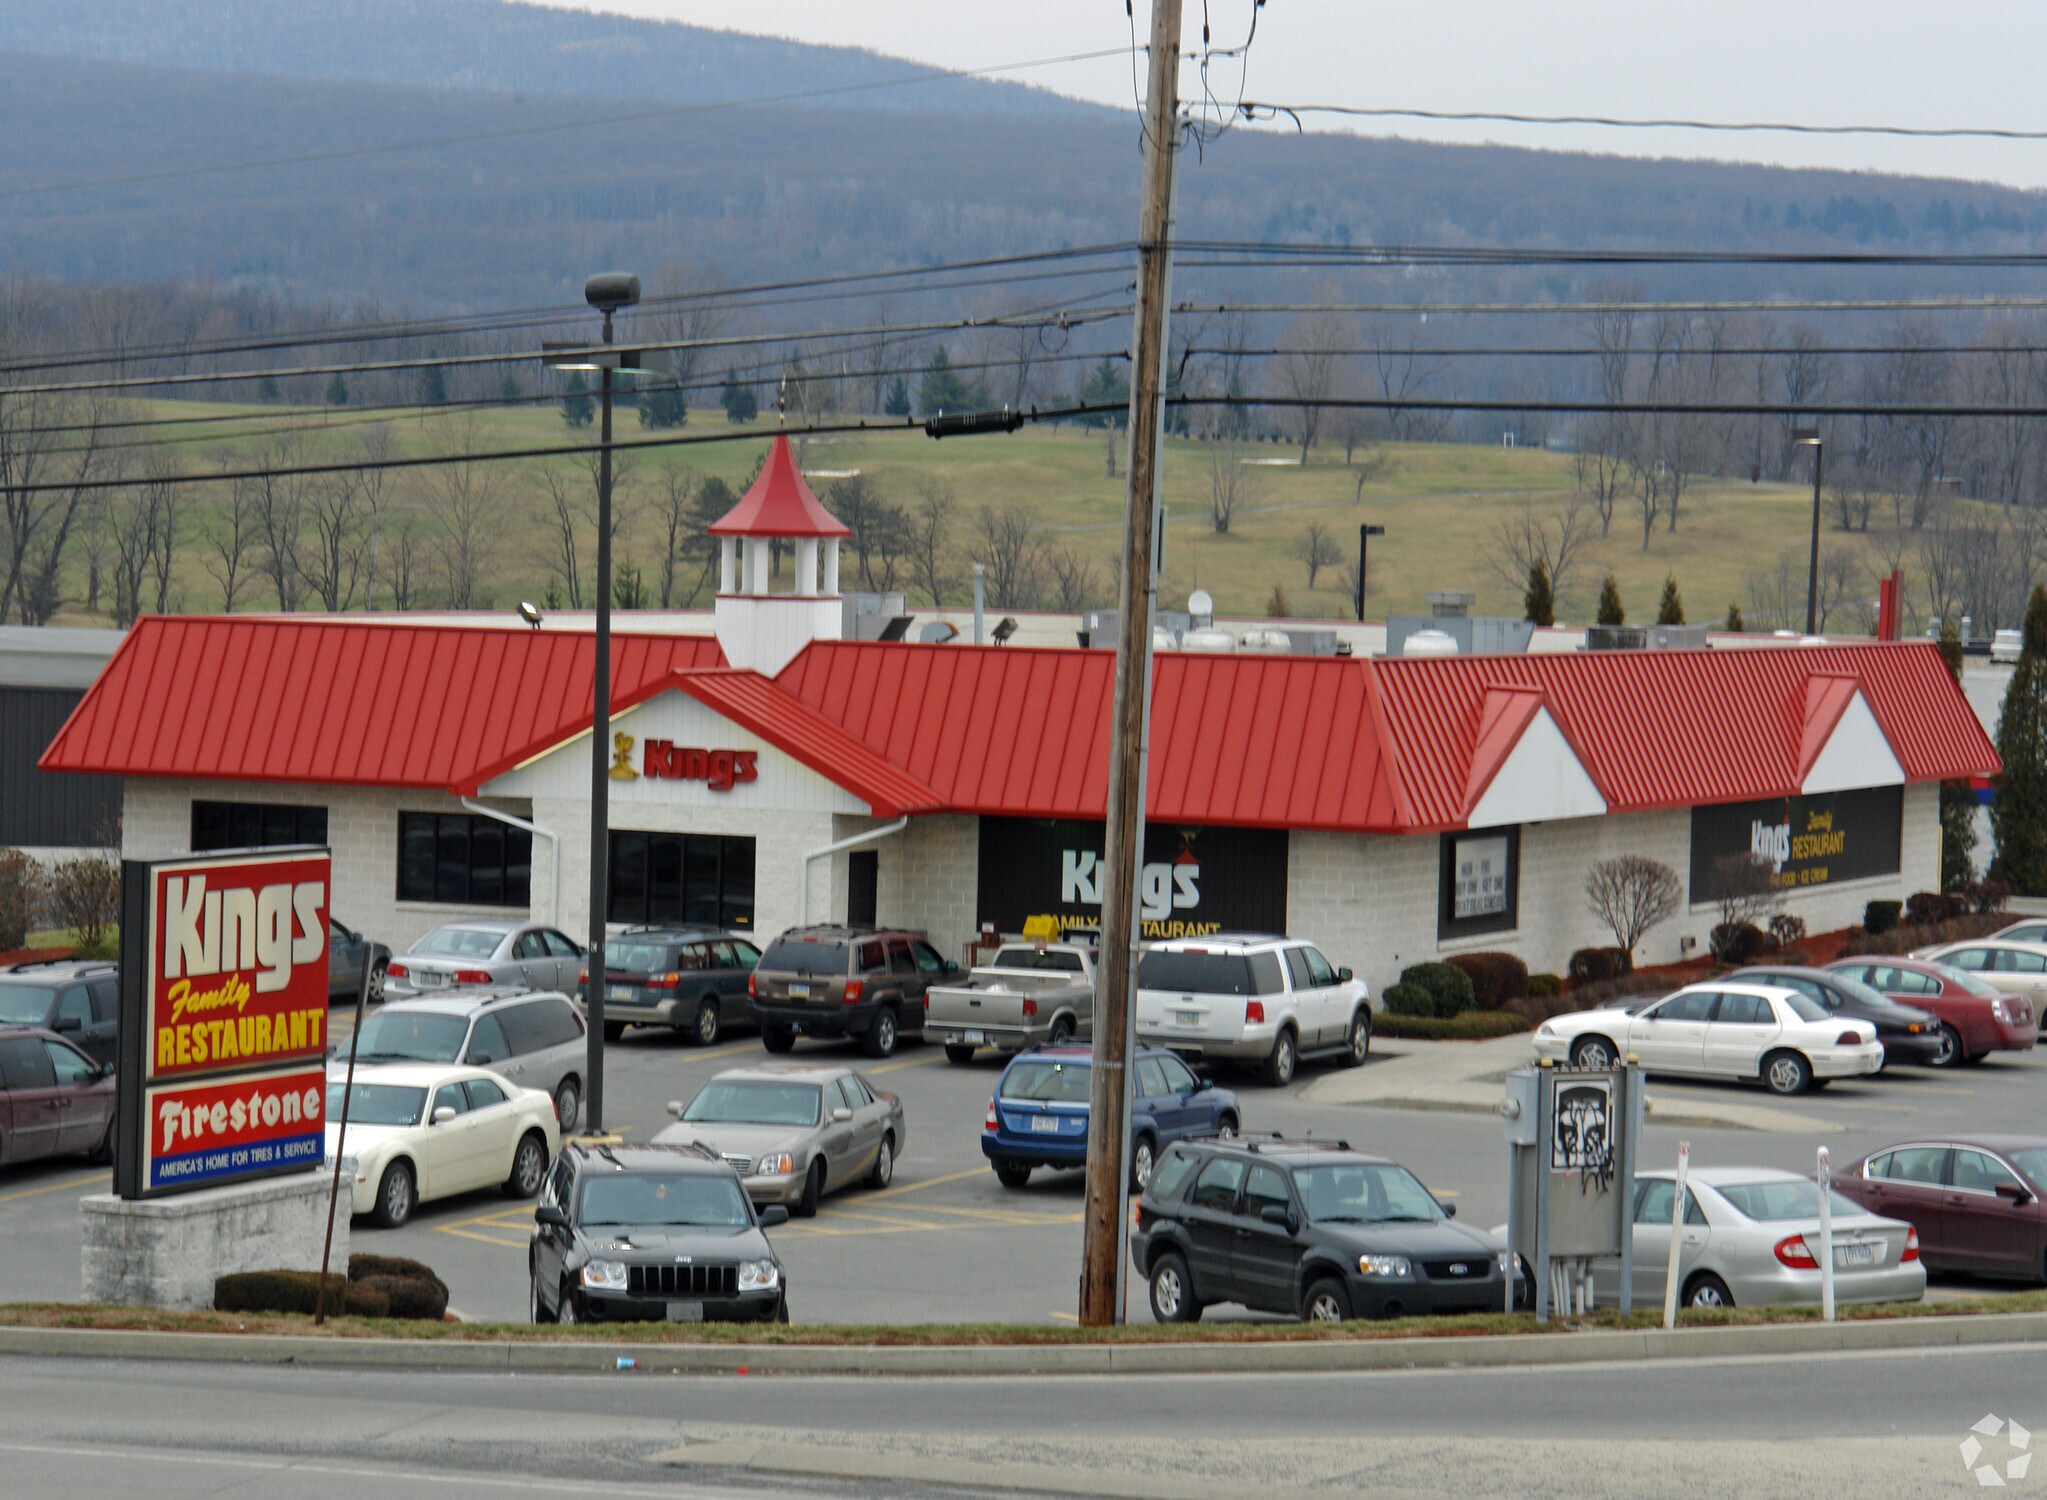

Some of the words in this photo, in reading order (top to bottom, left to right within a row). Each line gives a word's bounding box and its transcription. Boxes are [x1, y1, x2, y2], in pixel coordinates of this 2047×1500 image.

[643, 738, 758, 791] Kings
[1751, 819, 1790, 874] Kings
[1792, 830, 1845, 860] RESTAURANT
[1062, 849, 1200, 920] Kigs
[164, 873, 325, 993] Kings
[167, 972, 250, 1024] Family
[157, 1008, 324, 1067] RESTAURANT
[159, 1086, 321, 1152] Firestone
[159, 1157, 204, 1178] AMERICA'S
[205, 1153, 229, 1171] HOME
[231, 1149, 248, 1166] FOR
[251, 1147, 273, 1163] TIRES
[275, 1144, 281, 1159] &
[284, 1139, 316, 1157] SERVICE
